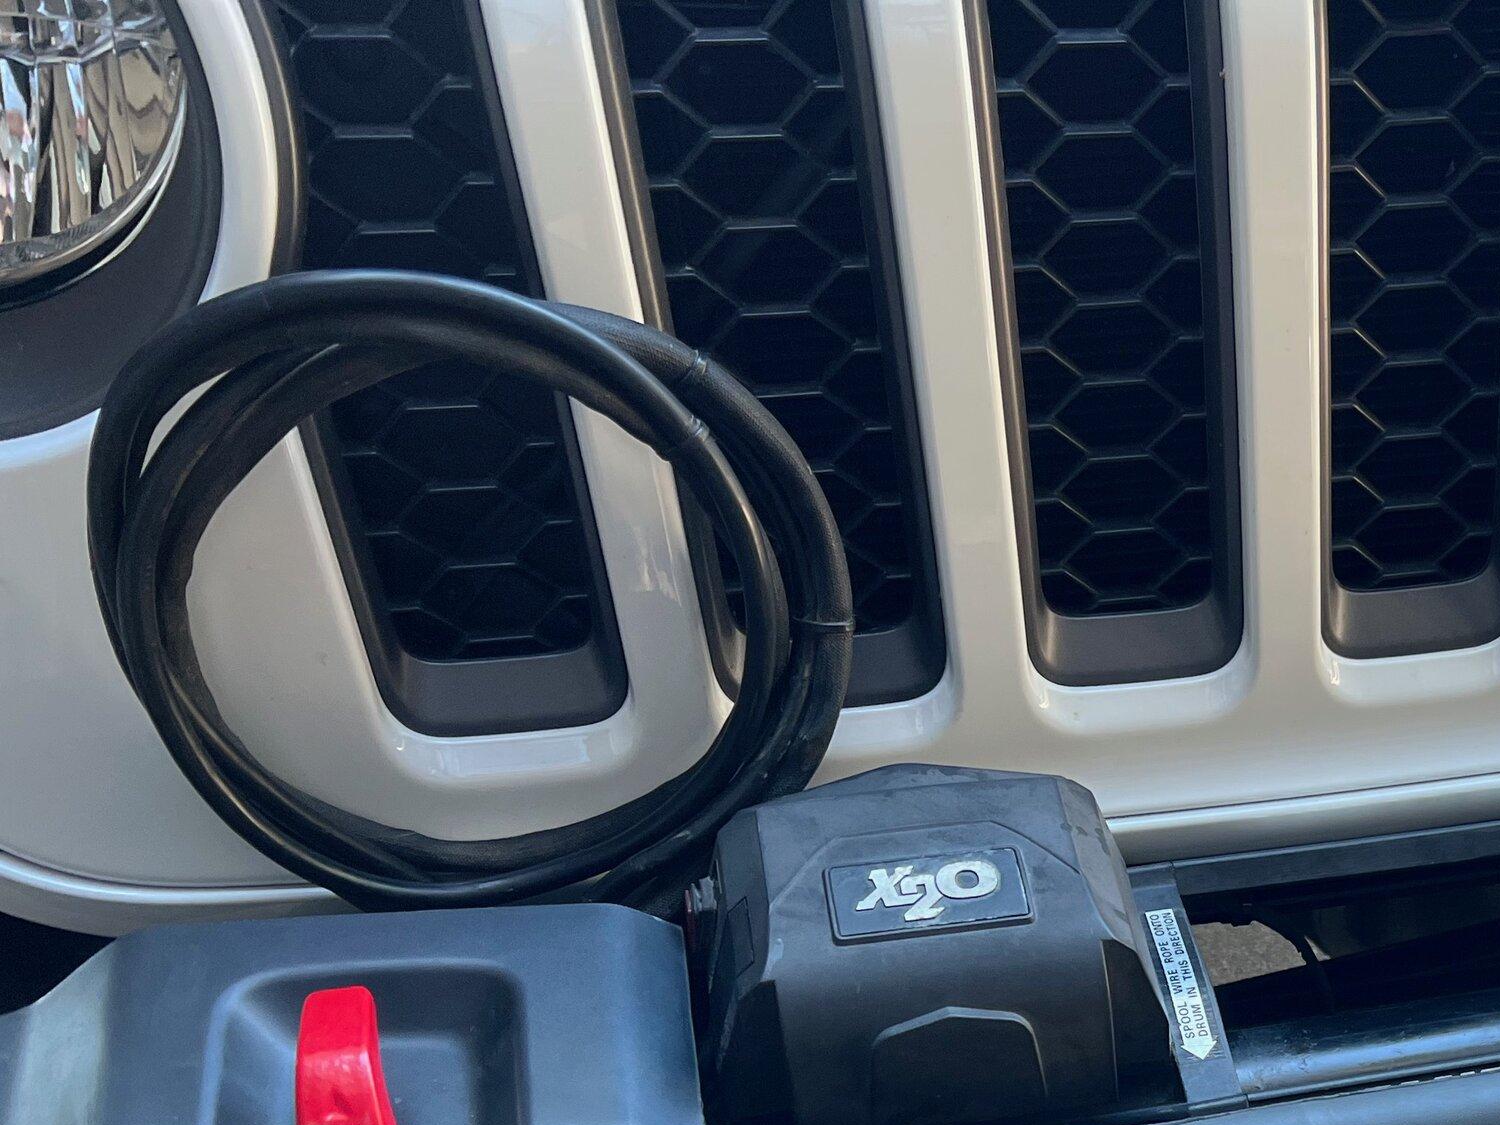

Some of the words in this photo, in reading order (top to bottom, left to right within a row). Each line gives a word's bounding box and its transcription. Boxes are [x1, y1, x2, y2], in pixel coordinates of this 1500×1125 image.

[1149, 914, 1165, 936] ONTO
[1162, 912, 1185, 955] DIRECTION
[1158, 941, 1174, 964] ROPE
[1167, 969, 1183, 995] WIRE
[1178, 960, 1193, 981] THIS
[1186, 986, 1198, 998] IN
[1177, 1001, 1195, 1039] SPOOL
[1191, 1004, 1208, 1037] DRUM
